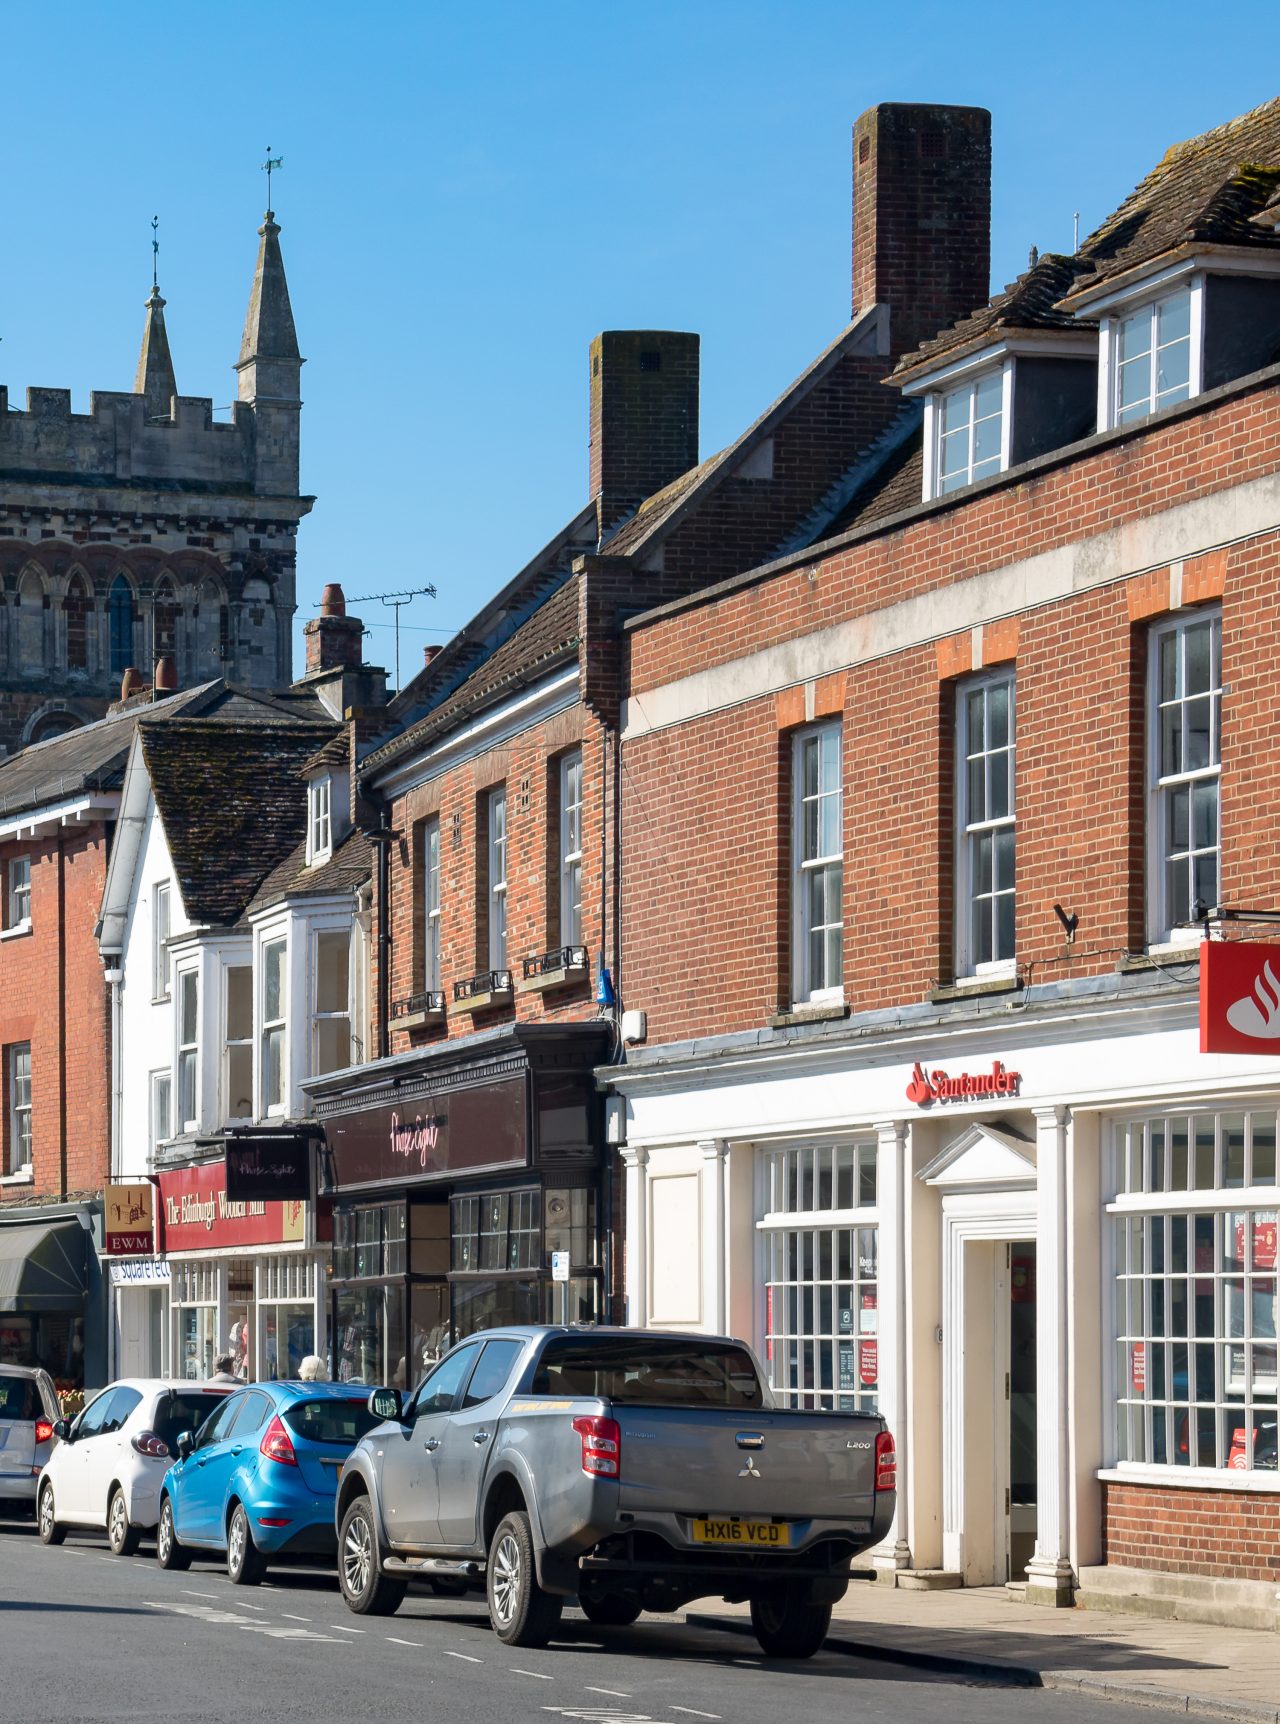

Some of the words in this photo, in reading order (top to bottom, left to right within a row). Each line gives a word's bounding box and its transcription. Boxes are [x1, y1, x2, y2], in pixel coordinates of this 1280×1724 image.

[930, 1061, 1019, 1099] Santander
[166, 1196, 180, 1225] The
[181, 1190, 216, 1231] Edinburgh
[112, 1238, 148, 1249] EWM
[846, 1441, 871, 1449] L200
[704, 1522, 741, 1539] HX16
[746, 1524, 779, 1541] VCD
